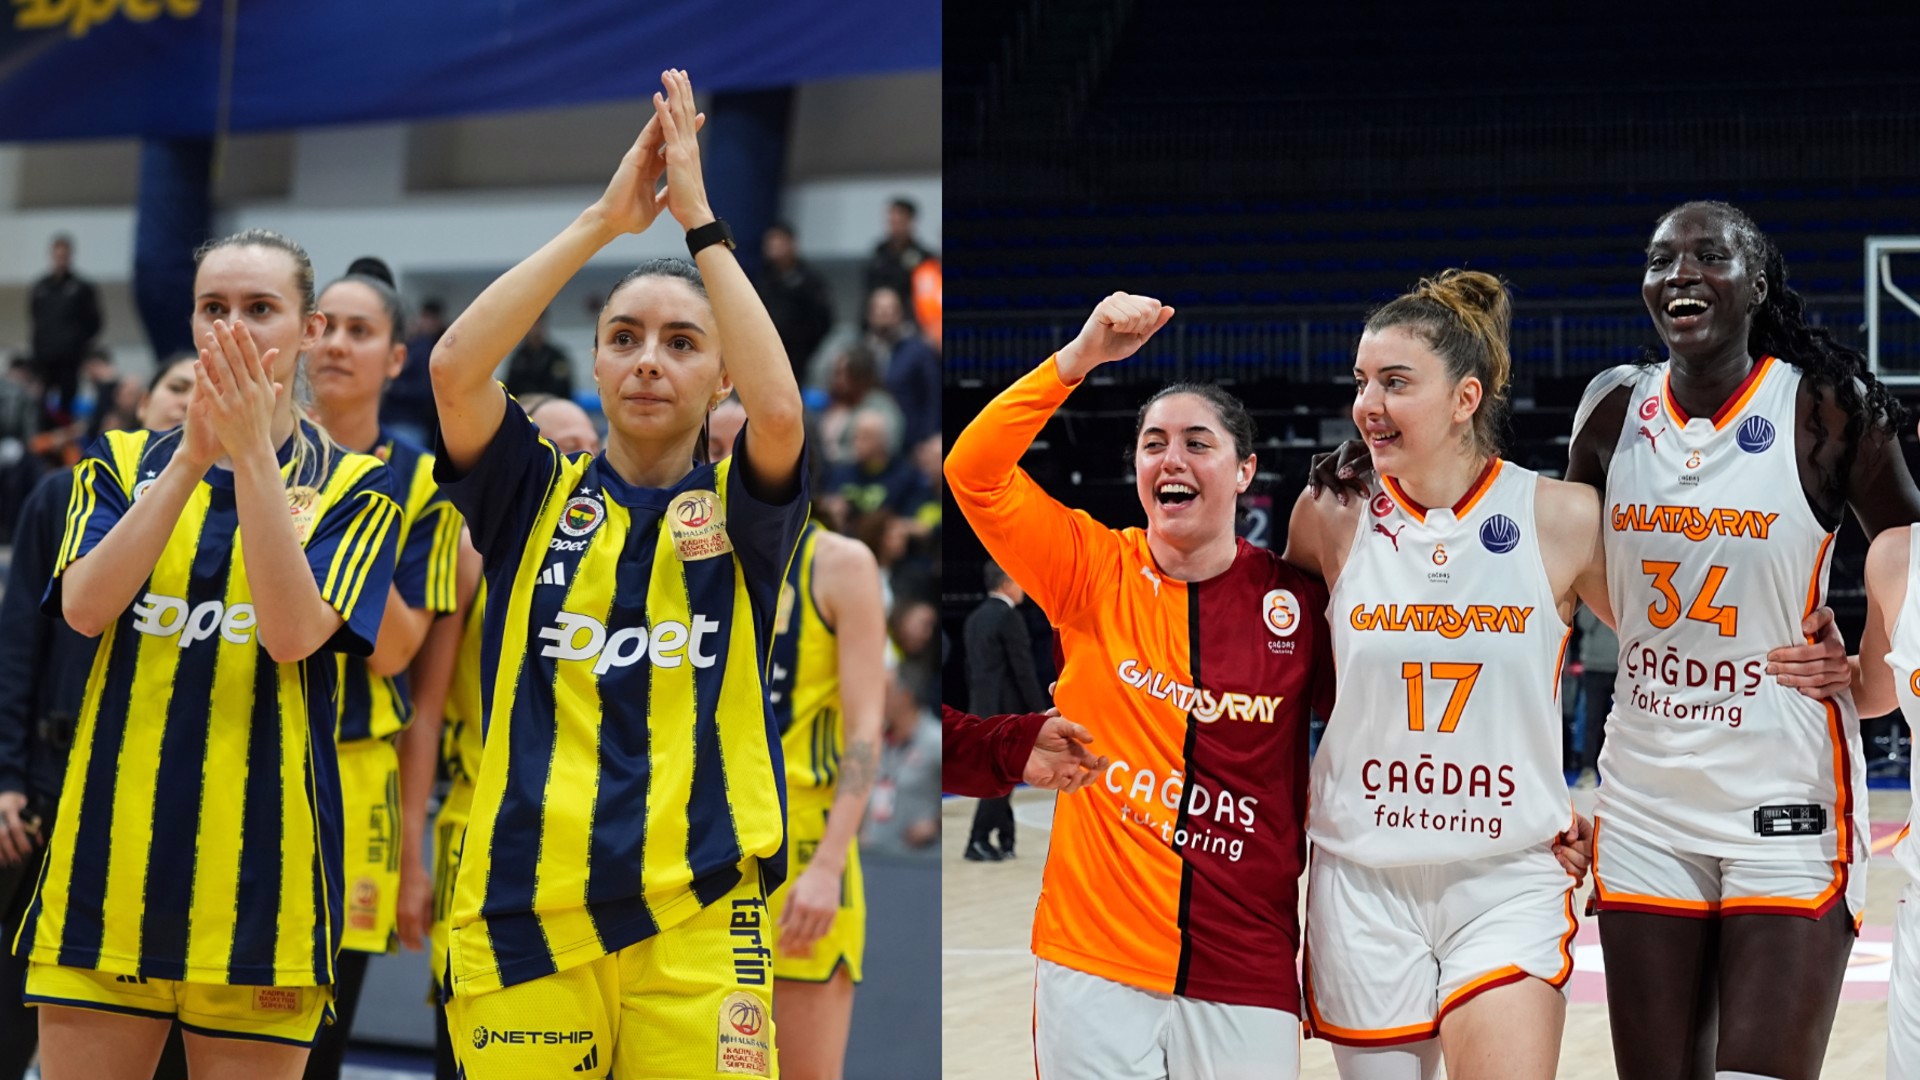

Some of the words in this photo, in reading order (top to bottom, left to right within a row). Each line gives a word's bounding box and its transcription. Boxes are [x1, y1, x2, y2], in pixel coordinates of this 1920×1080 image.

[1611, 503, 1779, 541] GALATASARAY
[132, 593, 268, 648] ope
[1350, 603, 1534, 639] GALATASARAY
[1641, 559, 1737, 637] 34
[1118, 659, 1284, 723] GALATASARAY
[1626, 641, 1762, 696] ÇAĞDAŞ
[1401, 662, 1483, 733] 17
[1631, 684, 1742, 727] faktoring
[1362, 754, 1515, 806] ÇAĞDAŞ
[1121, 804, 1243, 862] fatoring
[1374, 805, 1502, 839] faktoring
[730, 896, 772, 985] tarfin
[490, 1030, 594, 1045] NETSHIP
